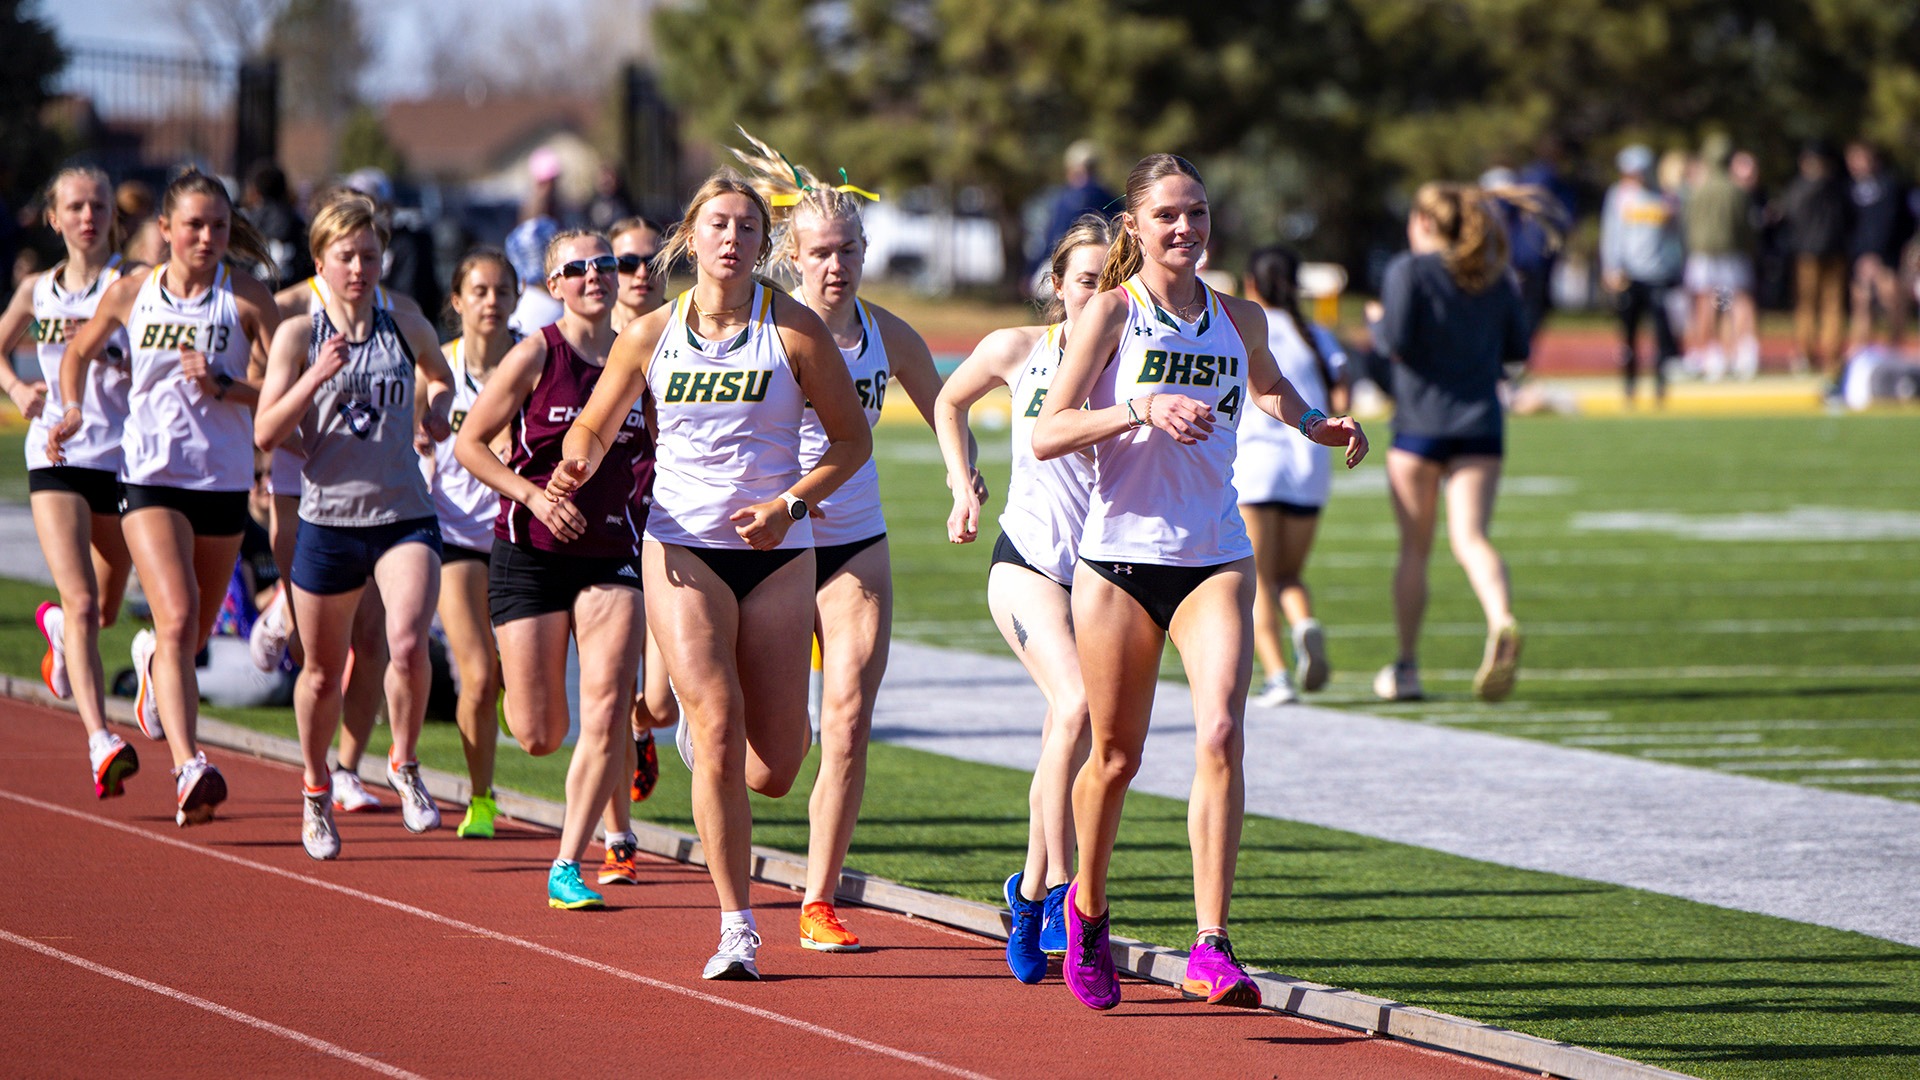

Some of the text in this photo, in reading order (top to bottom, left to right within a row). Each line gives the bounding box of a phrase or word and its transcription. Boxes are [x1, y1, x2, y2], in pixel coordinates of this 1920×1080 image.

[206, 325, 230, 352] 13
[375, 378, 404, 407] 10
[664, 370, 773, 403] BHSU
[1217, 385, 1241, 421] 4
